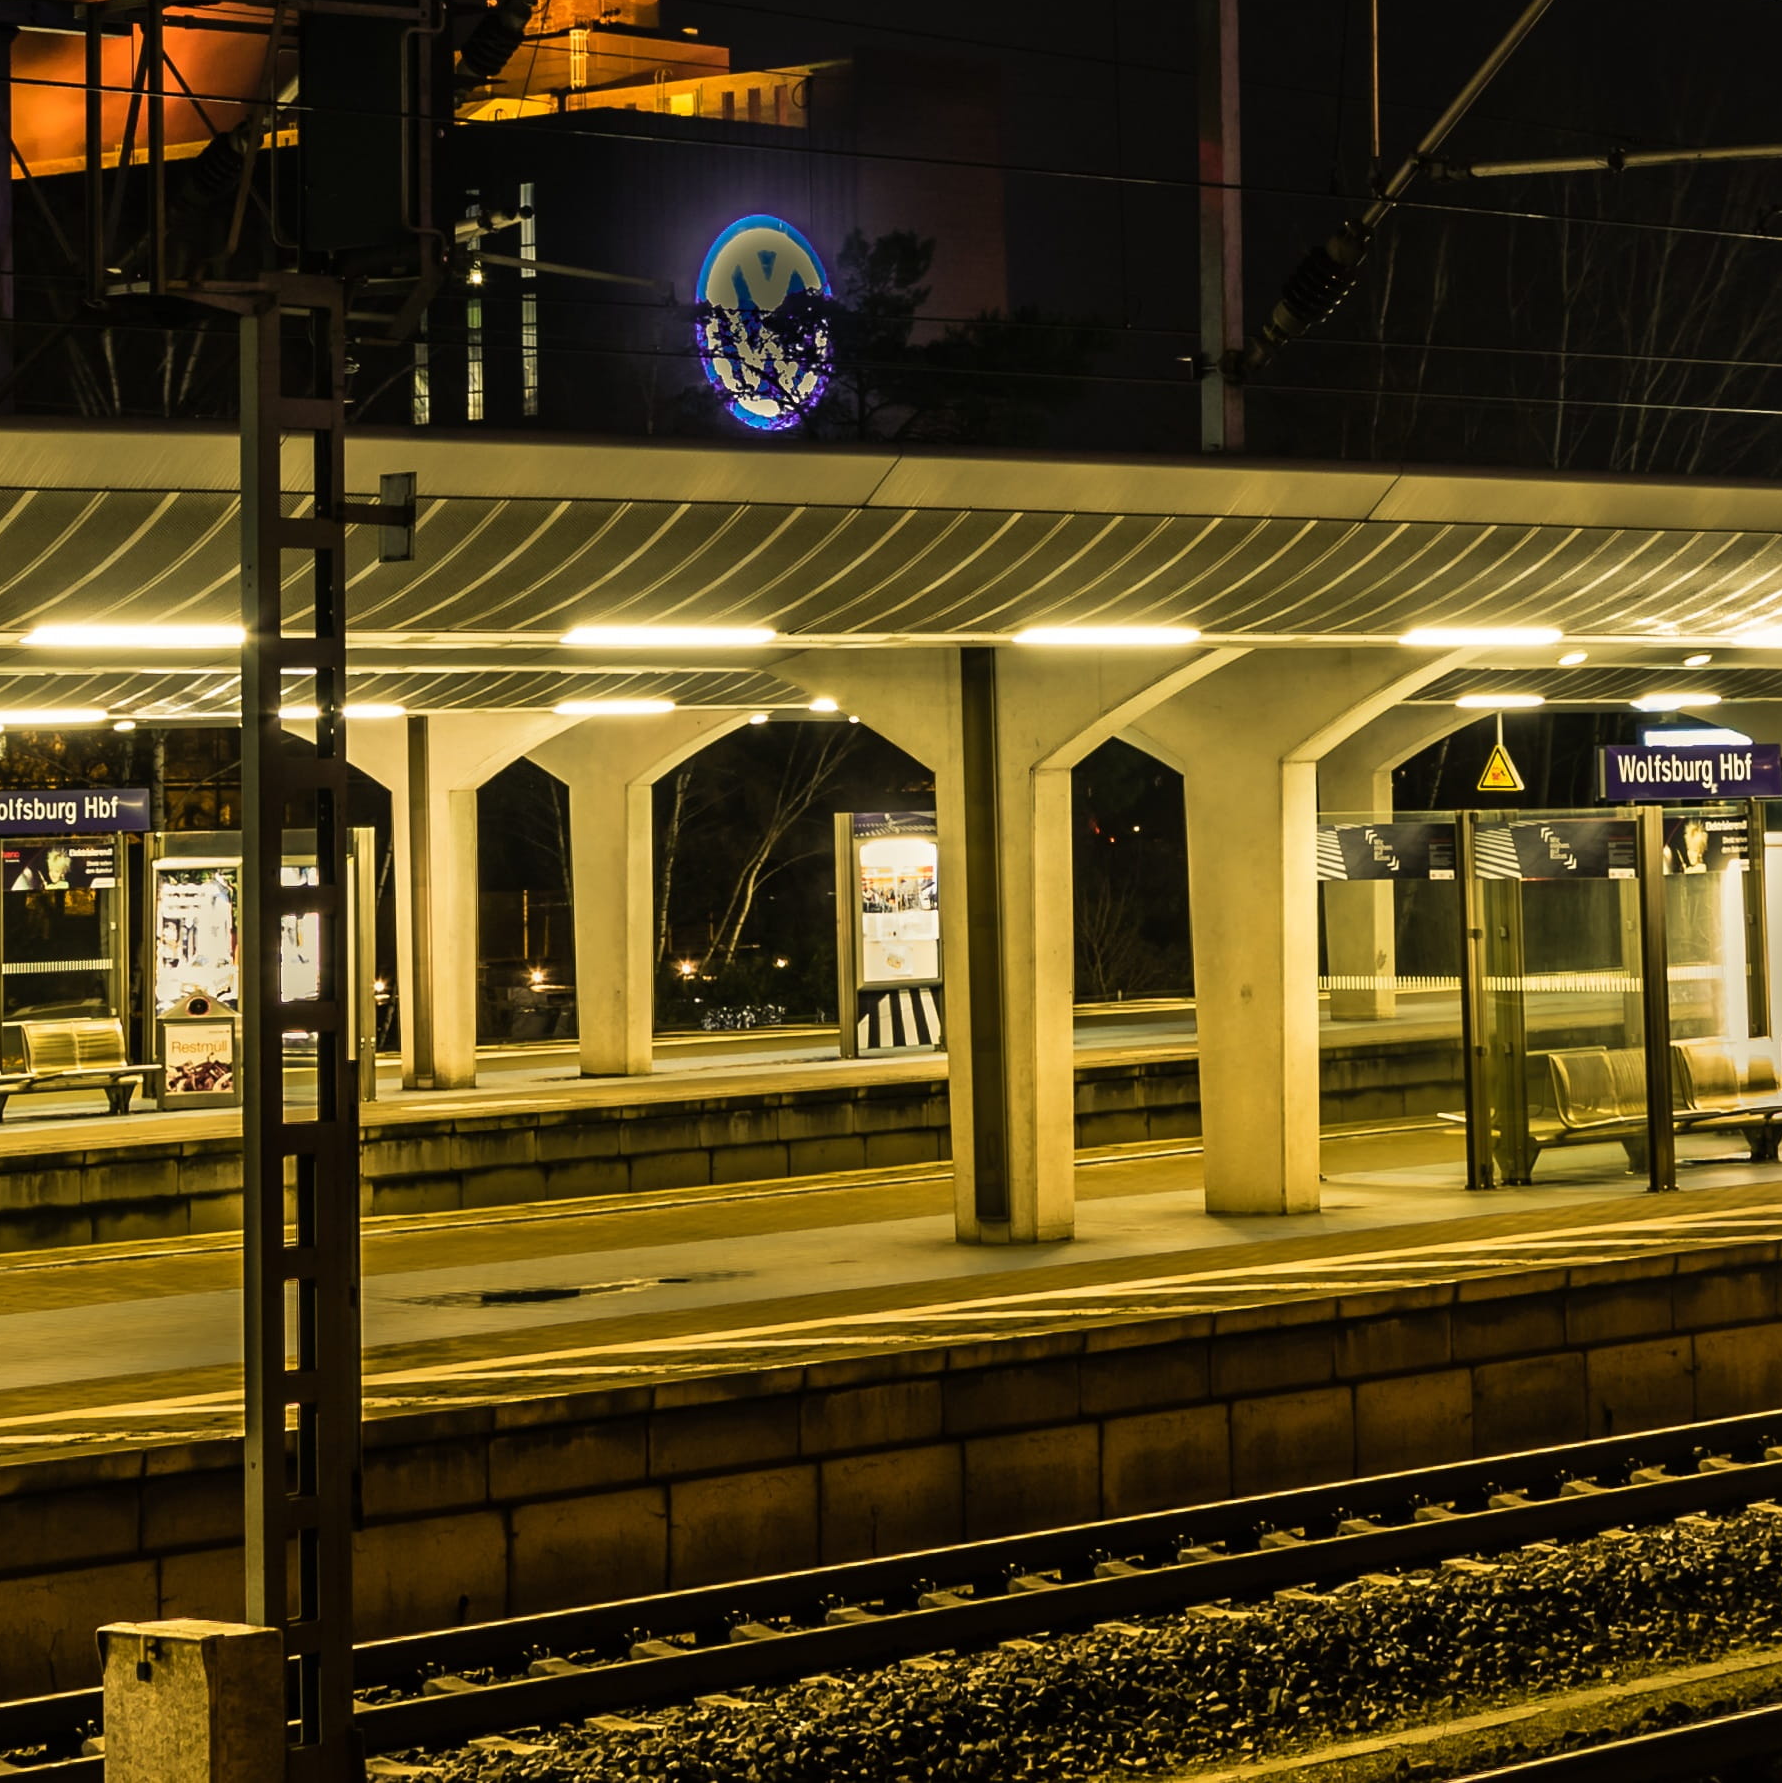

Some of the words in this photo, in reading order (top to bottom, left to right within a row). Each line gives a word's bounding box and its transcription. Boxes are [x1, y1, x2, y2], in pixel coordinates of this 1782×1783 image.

[1617, 753, 1714, 789] Wolfsburg
[1719, 752, 1753, 781] Hbf
[84, 795, 119, 819] Hbf
